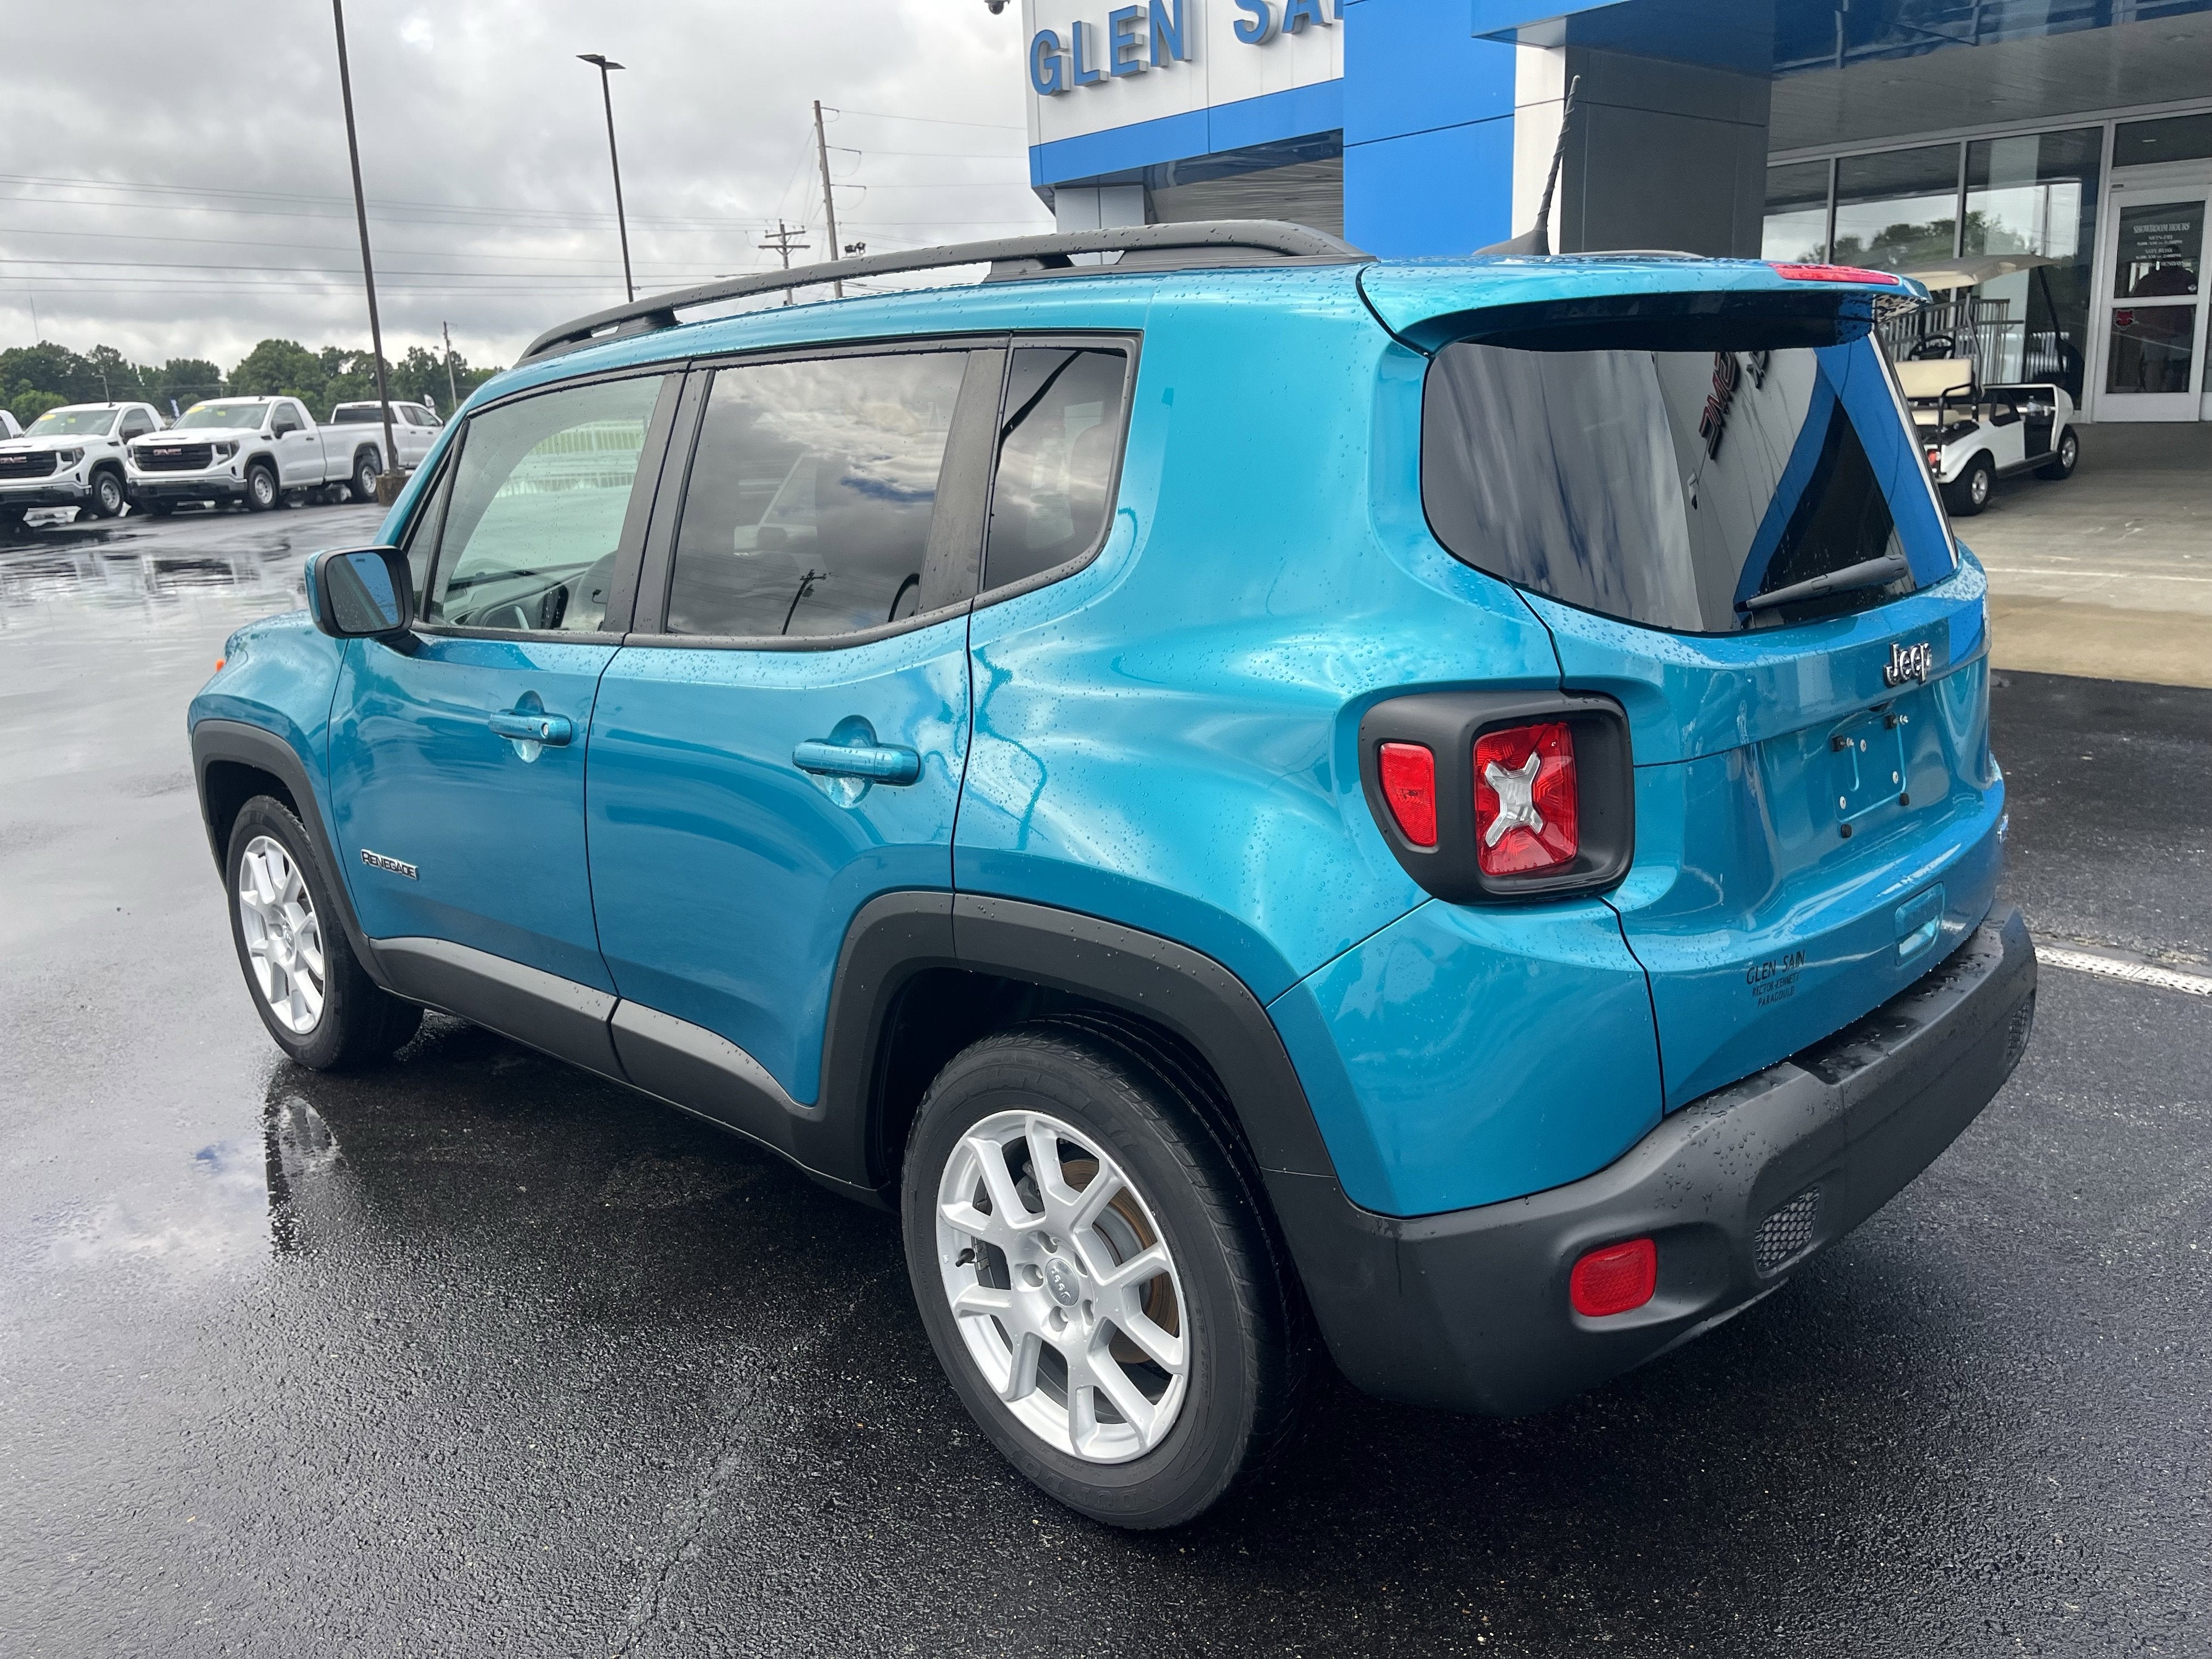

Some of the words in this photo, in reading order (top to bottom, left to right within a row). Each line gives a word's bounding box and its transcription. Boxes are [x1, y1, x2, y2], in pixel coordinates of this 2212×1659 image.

[1030, 0, 1189, 96] GLEN
[1883, 642, 1932, 688] Jeep
[361, 849, 418, 880] RENEGADE
[1746, 959, 1776, 985] GLEN
[1782, 949, 1805, 973] SAIN
[1758, 985, 1795, 1007] PARAGOULD
